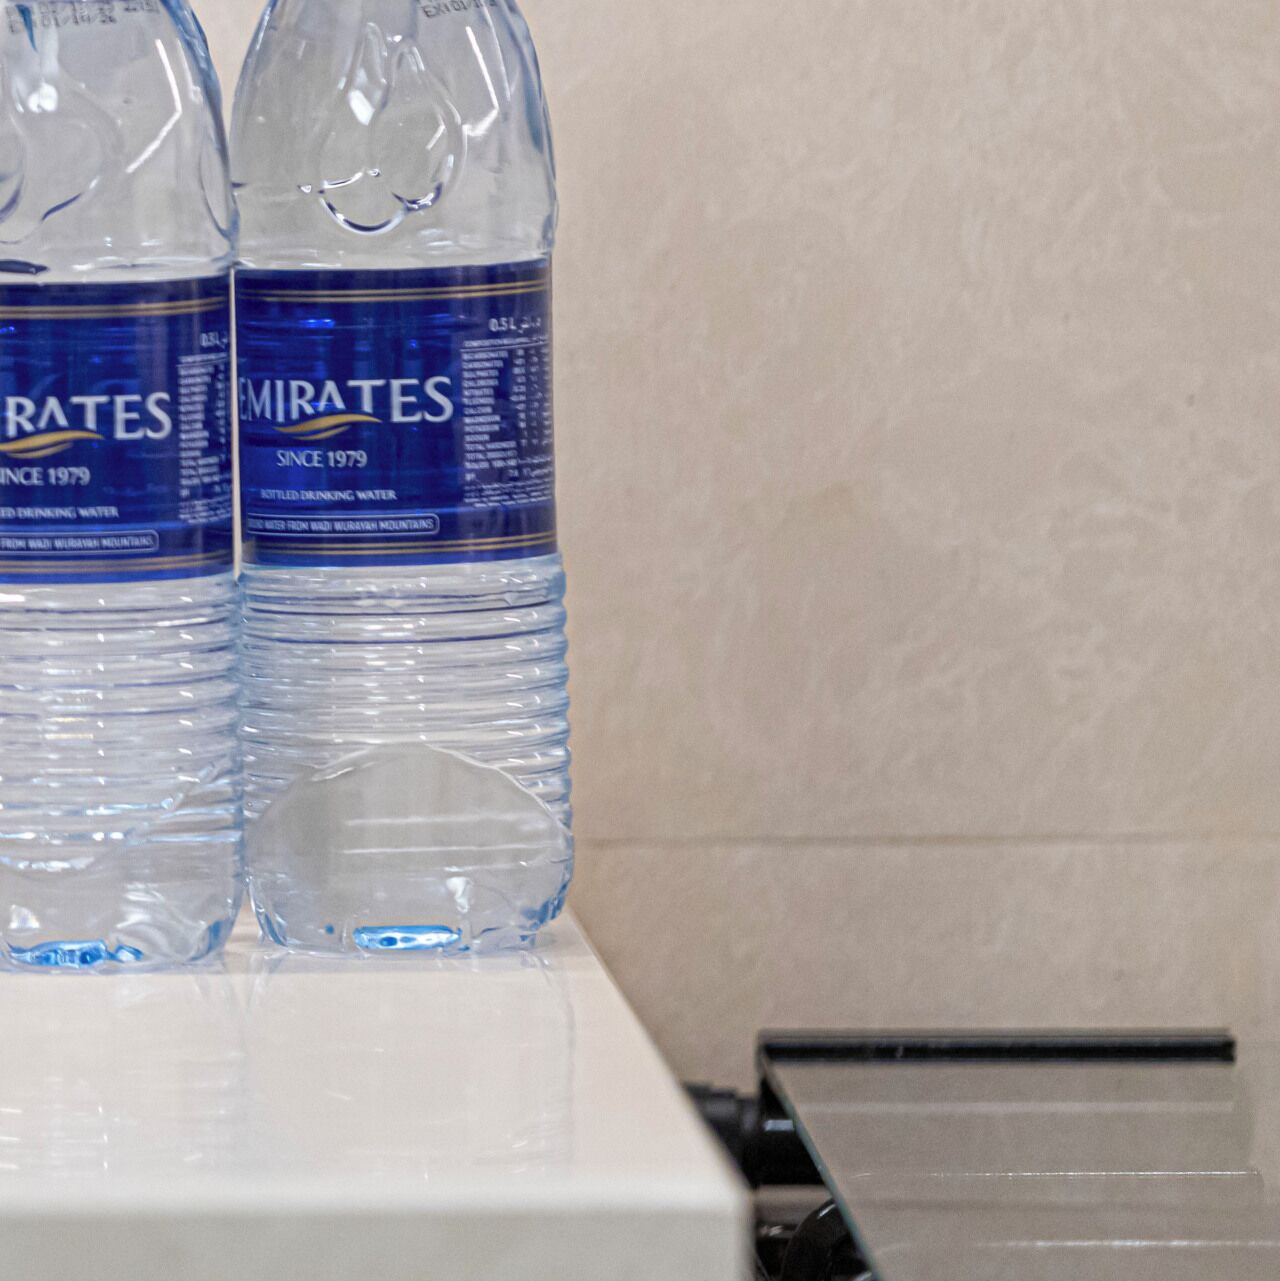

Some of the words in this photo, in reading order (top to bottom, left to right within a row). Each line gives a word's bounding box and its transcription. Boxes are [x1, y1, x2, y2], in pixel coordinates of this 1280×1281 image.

[239, 375, 455, 425] EMIRATES
[276, 449, 324, 468] SINCE
[327, 449, 368, 468] 1979
[47, 466, 91, 486] 1979
[260, 488, 299, 501] BOTTLED
[299, 489, 355, 502] DRINKING
[355, 488, 398, 501] WATER
[16, 506, 77, 520] DRINKING
[77, 505, 120, 519] WATER
